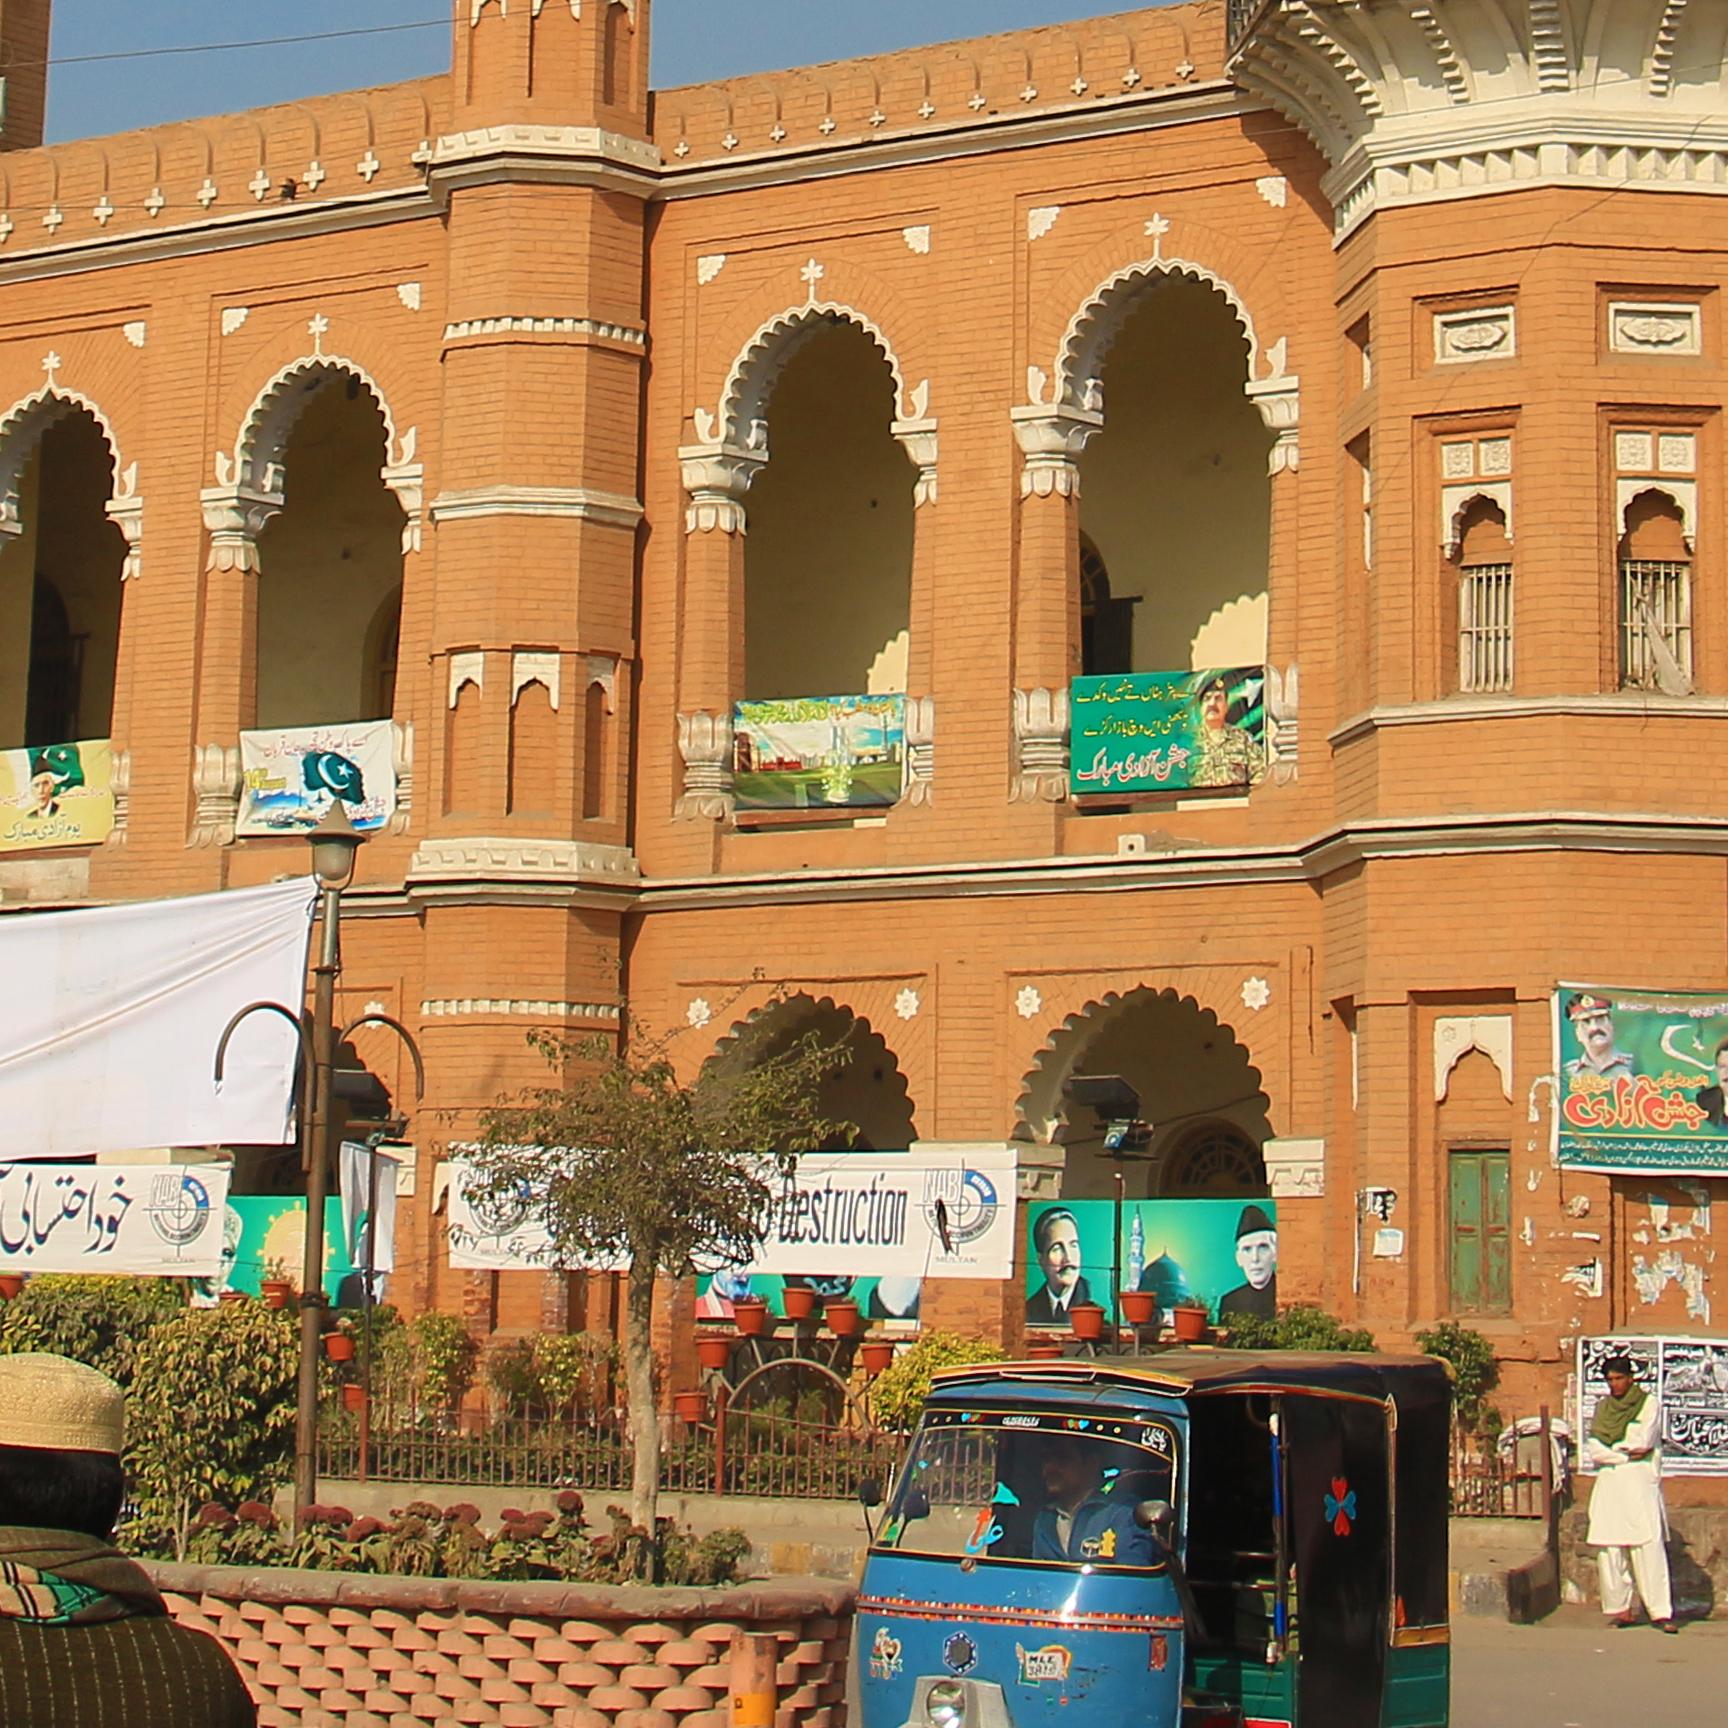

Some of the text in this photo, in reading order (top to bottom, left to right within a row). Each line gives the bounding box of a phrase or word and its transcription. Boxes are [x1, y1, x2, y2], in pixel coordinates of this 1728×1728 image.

[1077, 743, 1190, 786] جشن آزادی مبارک
[3, 821, 38, 842] مبارک
[36, 813, 67, 841] آزادی
[1562, 1075, 1710, 1132] جشن آزادی
[923, 1168, 961, 1204] NAB
[0, 1171, 98, 1256] احتسابی
[84, 1175, 134, 1255] خود
[935, 1256, 977, 1264] MULTAN
